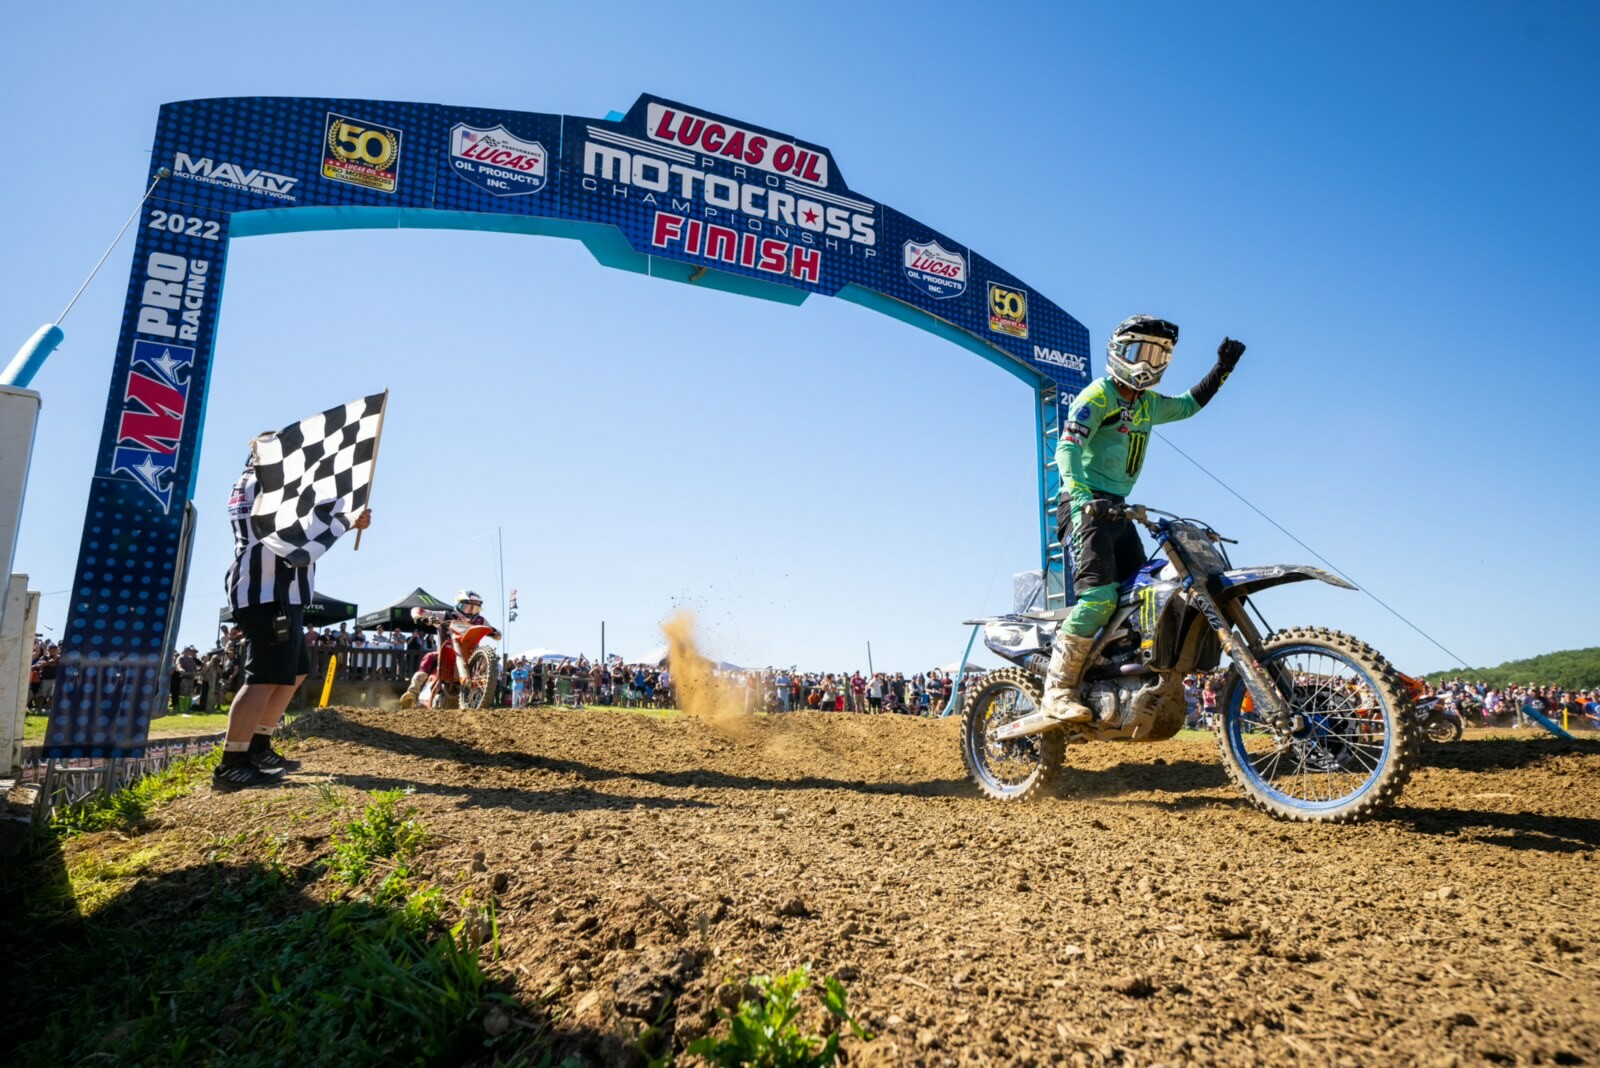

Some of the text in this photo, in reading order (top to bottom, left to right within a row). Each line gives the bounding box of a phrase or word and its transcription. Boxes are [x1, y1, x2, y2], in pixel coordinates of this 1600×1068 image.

[335, 123, 392, 165] 50
[461, 143, 539, 171] LUCAS
[655, 110, 821, 183] LUCAS OIL
[173, 151, 299, 194] MAVTV
[327, 165, 343, 174] PRO
[344, 163, 366, 173] LUCAS
[366, 167, 377, 175] OIL
[455, 160, 540, 186] OIL PRODUCTS
[487, 178, 511, 190] INC.
[702, 156, 780, 188] PRO
[173, 170, 297, 202] MOTORSPORTS NETWORK
[583, 141, 876, 246] MOTOCROSS
[148, 209, 221, 241] 2022
[581, 177, 877, 258] CHAMPIONSHIP
[651, 210, 822, 284] FINISH
[907, 270, 963, 290] OIL PRODUCTS
[911, 256, 961, 278] LUCAS
[137, 251, 188, 338] PRO
[178, 259, 209, 342] RACING
[928, 284, 944, 294] INC.
[994, 288, 1023, 319] 50
[1060, 391, 1075, 406] 20
[111, 338, 196, 515] AMA
